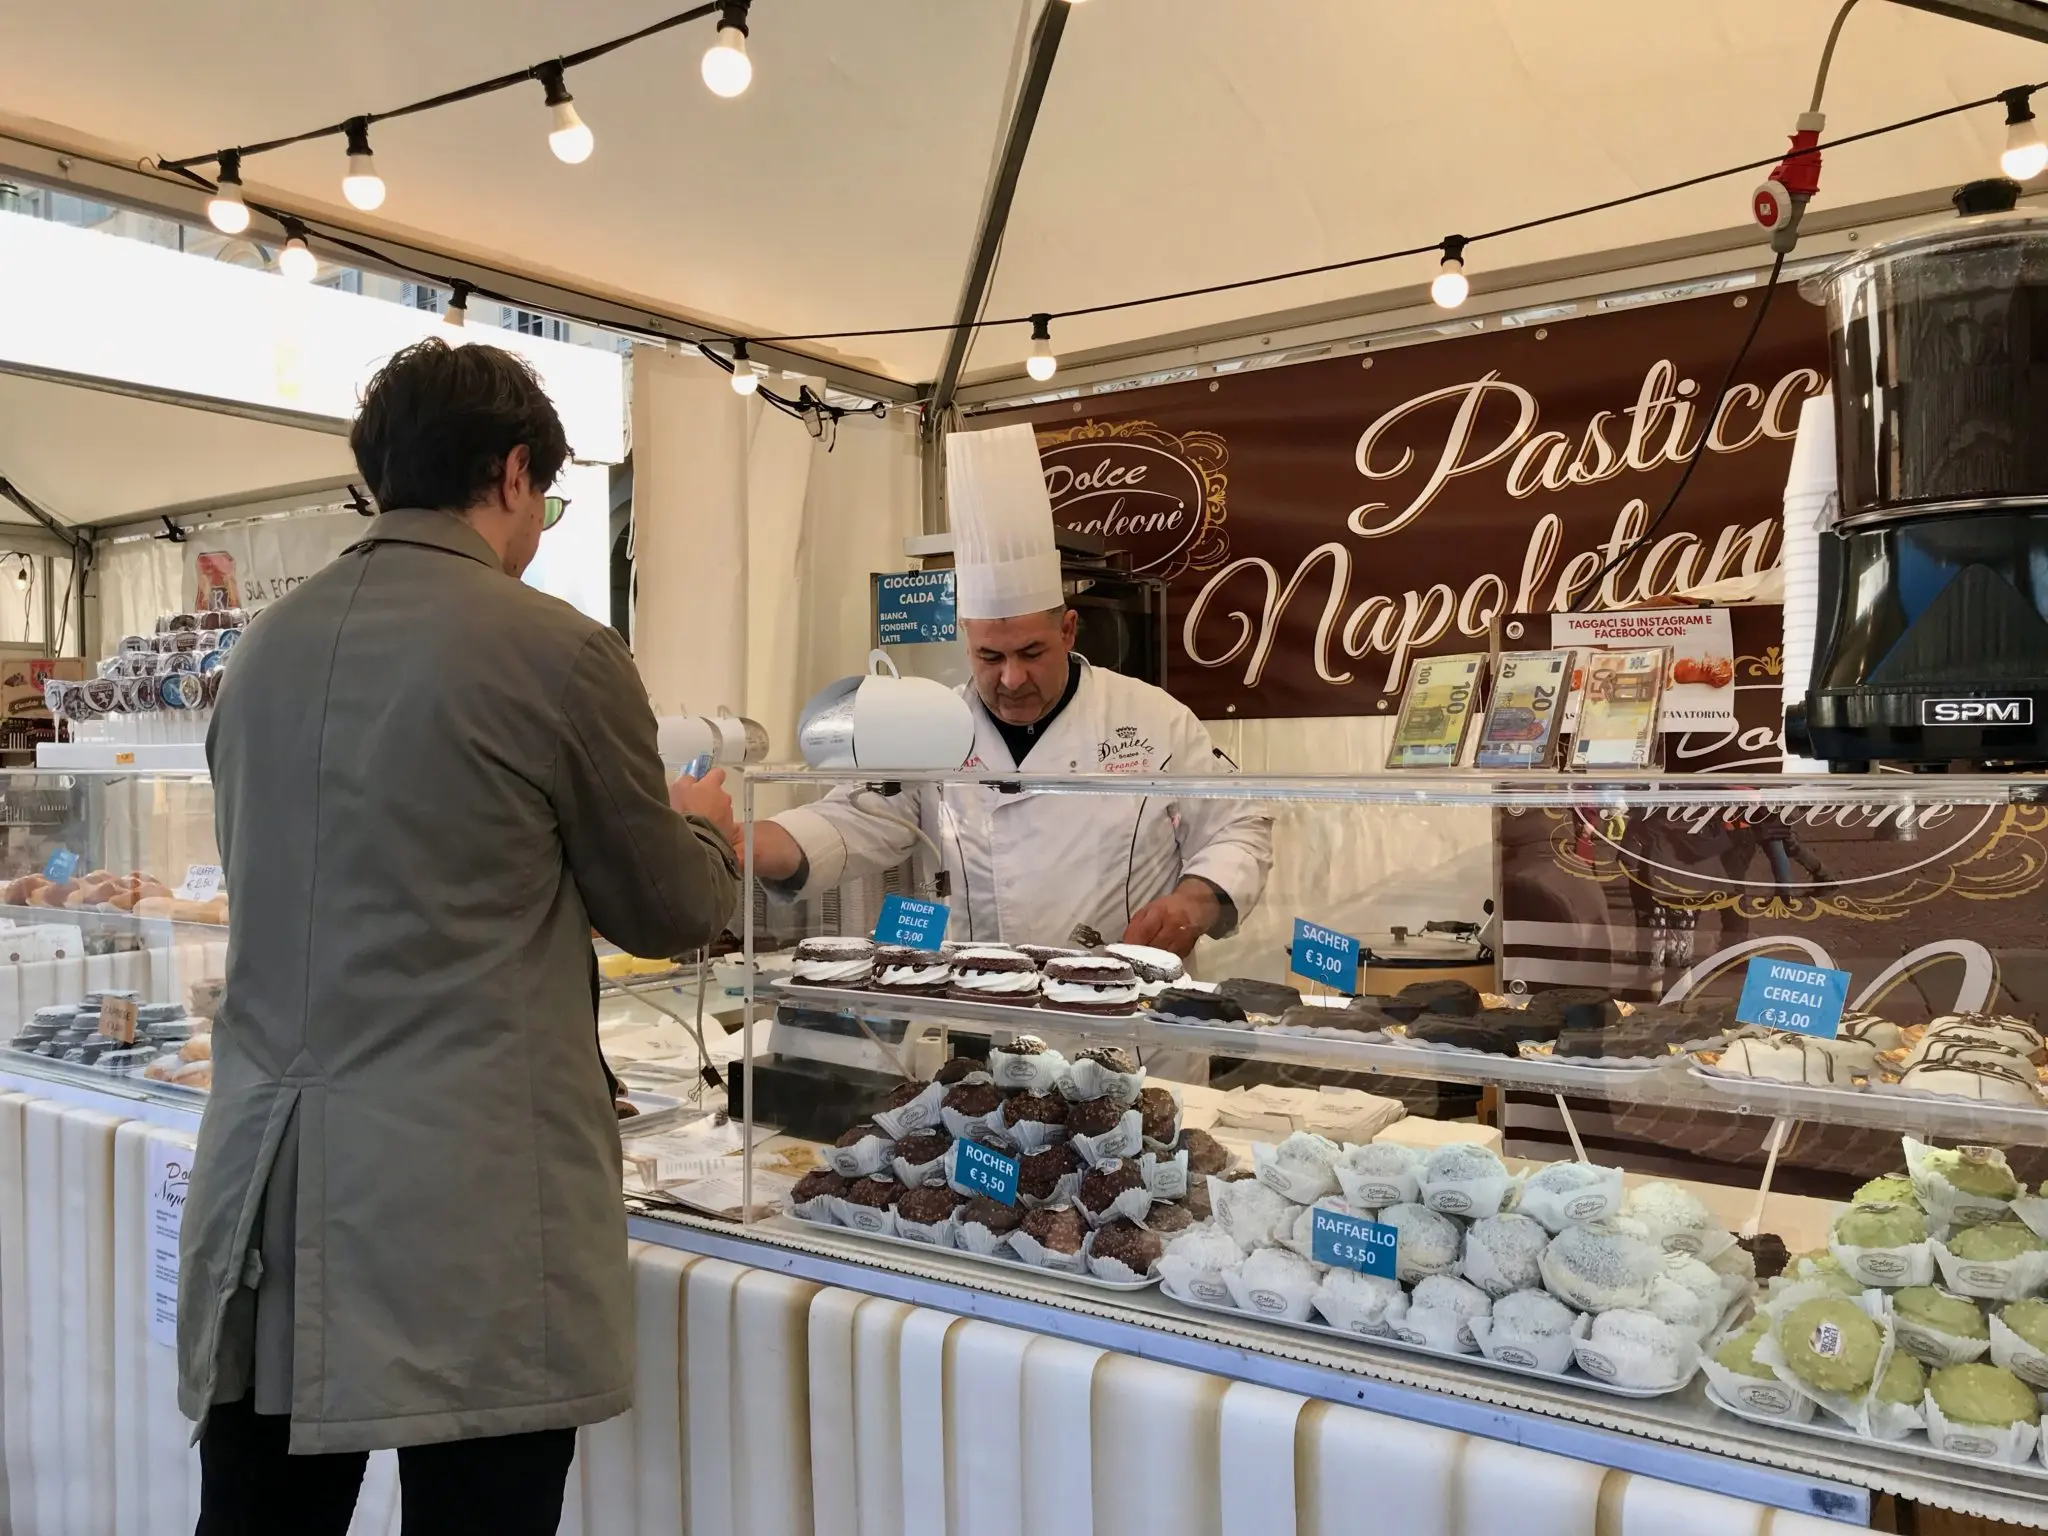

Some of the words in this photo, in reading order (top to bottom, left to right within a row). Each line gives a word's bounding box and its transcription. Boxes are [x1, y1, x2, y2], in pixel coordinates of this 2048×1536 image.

[1347, 359, 1832, 537] Pasticc
[1043, 458, 1147, 499] Dolce
[883, 574, 951, 589] CIOCCOLATA
[900, 592, 934, 604] CALDA
[1182, 498, 1784, 693] Napoletan
[880, 612, 908, 620] BIANCA
[1568, 618, 1617, 629] TAGGACI
[1620, 618, 1634, 627] SU
[1636, 615, 1703, 627] INSTAGRAM
[1706, 615, 1712, 624] E
[881, 622, 918, 632] FONDENTE
[1594, 627, 1653, 639] FACEBOOK
[1656, 627, 1686, 636] CON:
[881, 635, 901, 643] LATTE
[1502, 664, 1517, 679] 20
[1447, 681, 1470, 714] 100
[1532, 686, 1556, 711] 20
[1935, 702, 2020, 721] SPM
[900, 901, 935, 915] KINDER
[898, 915, 929, 929] DELICE
[1303, 925, 1349, 953] SACHER
[1305, 949, 1314, 963] €
[1315, 952, 1342, 974] 3,00
[1770, 965, 1826, 987] KINDER
[1763, 986, 1823, 1008] CEREALI
[1777, 1010, 1810, 1028] 3,00
[966, 1145, 1014, 1177] ROCHER
[970, 1168, 978, 1180] €
[979, 1172, 1005, 1193] 3,50
[1317, 1216, 1396, 1247] RAFFAELLO
[1333, 1242, 1342, 1256] €
